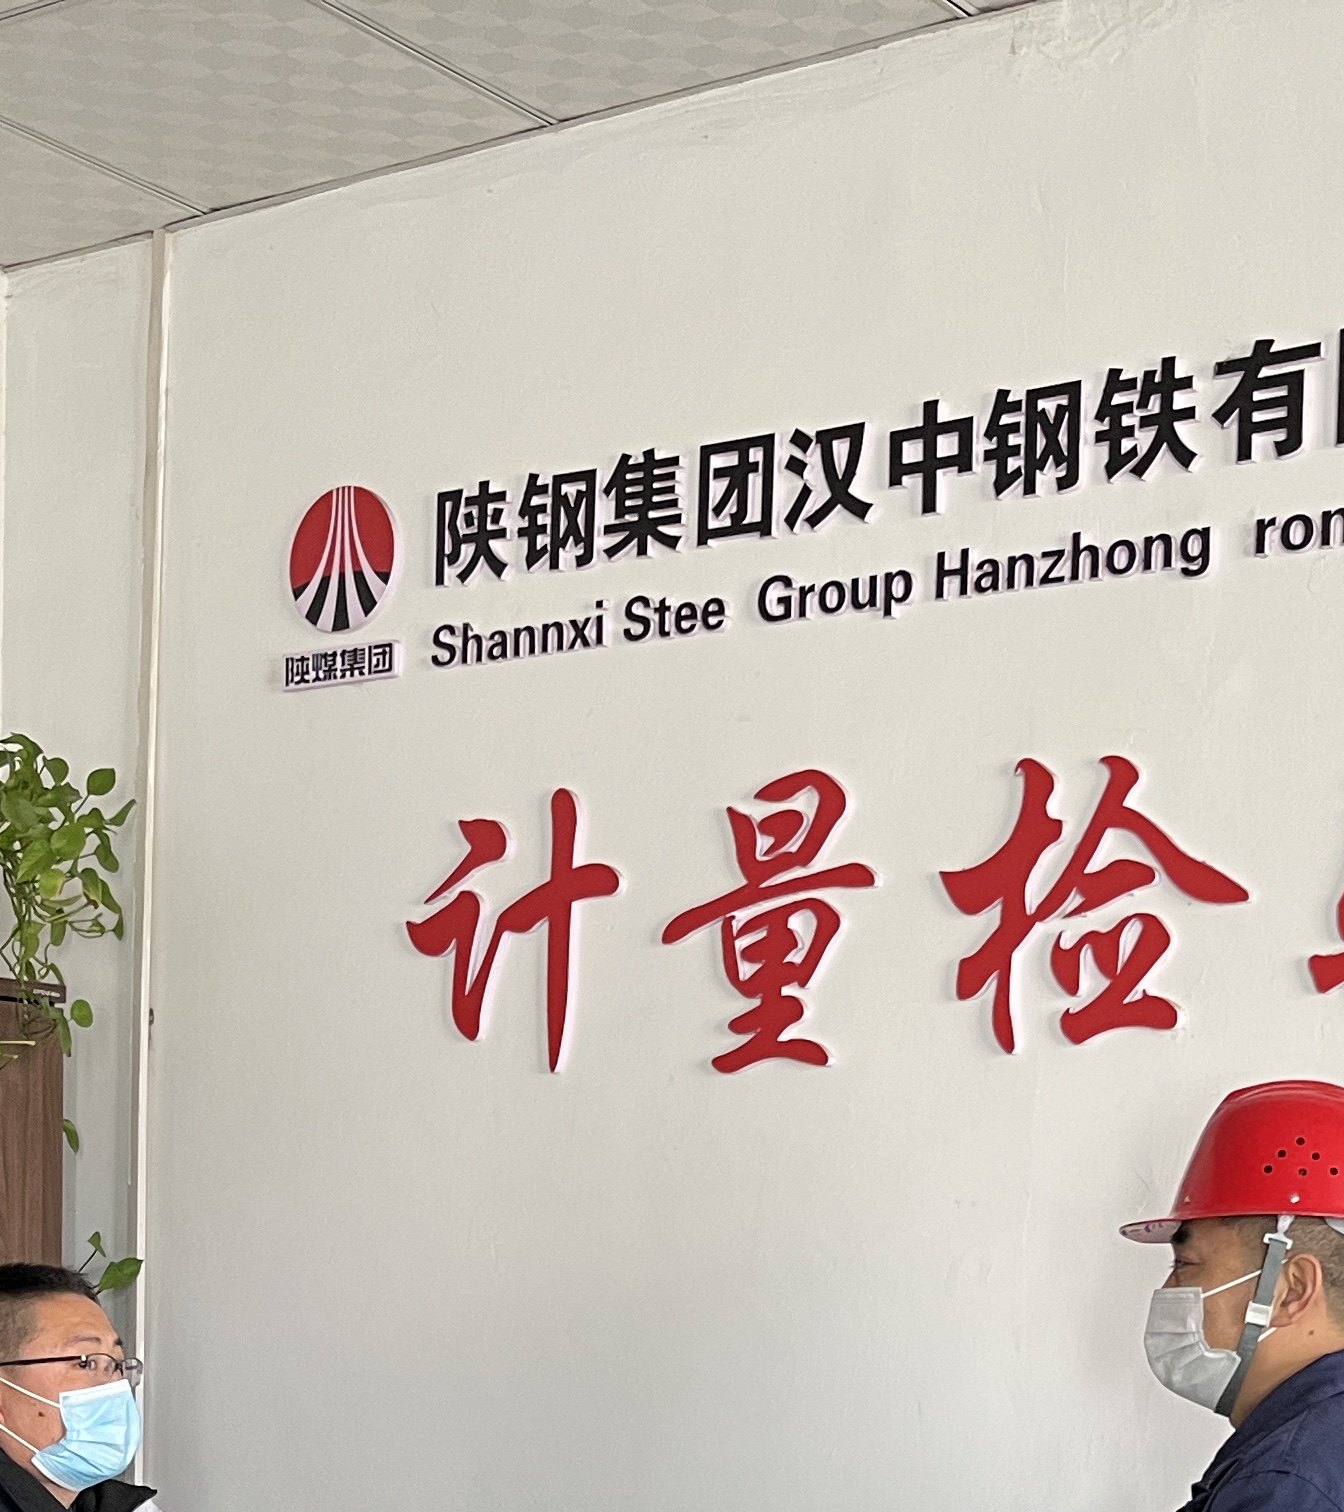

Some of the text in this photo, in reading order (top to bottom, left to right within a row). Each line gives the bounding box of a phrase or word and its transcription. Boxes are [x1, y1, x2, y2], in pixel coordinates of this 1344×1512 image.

[431, 599, 604, 667] Shannxi
[623, 595, 727, 642] Stee
[757, 569, 914, 623] Group
[935, 526, 1212, 600] Hanzhong
[284, 642, 394, 688] 陕煤集团
